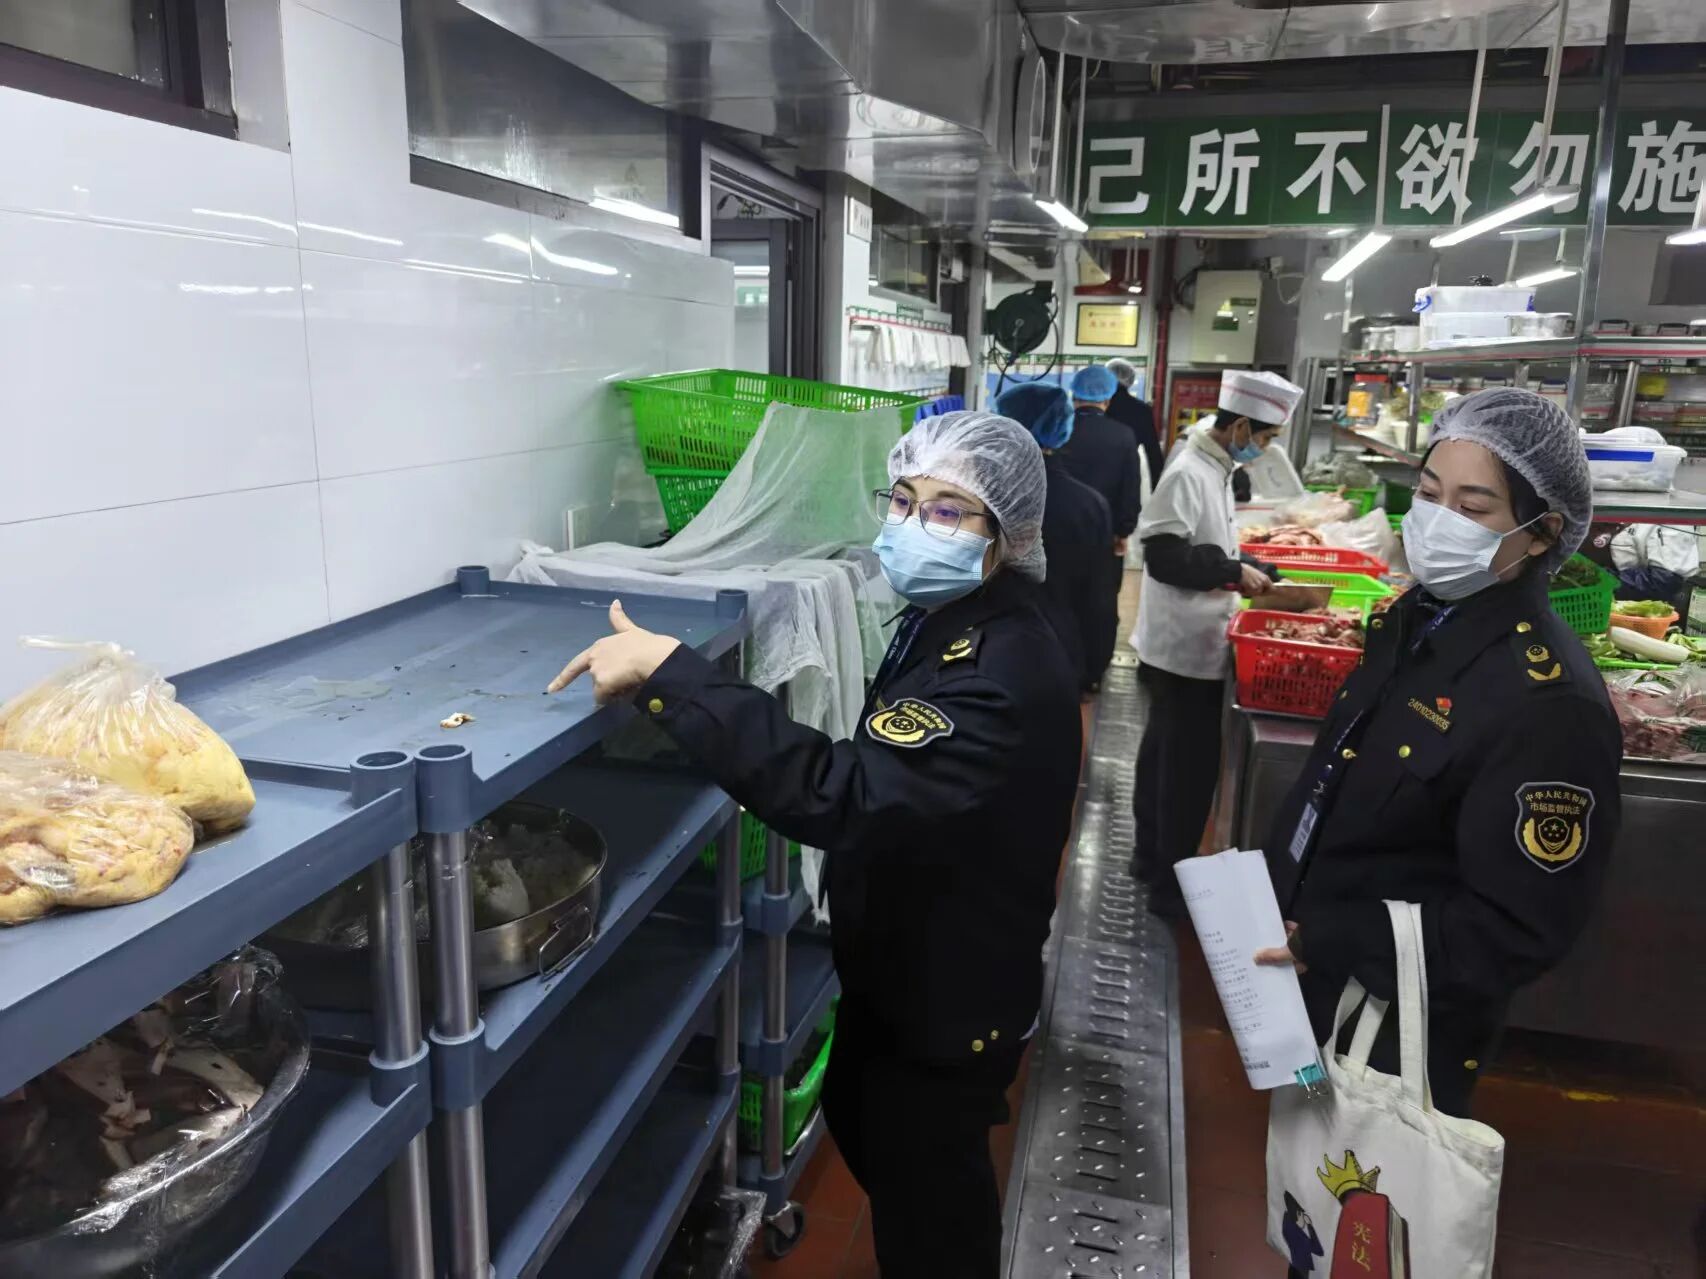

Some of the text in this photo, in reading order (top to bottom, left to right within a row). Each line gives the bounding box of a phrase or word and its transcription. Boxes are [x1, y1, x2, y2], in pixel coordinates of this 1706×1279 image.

[1087, 120, 1706, 216] 己所不欲勿施
